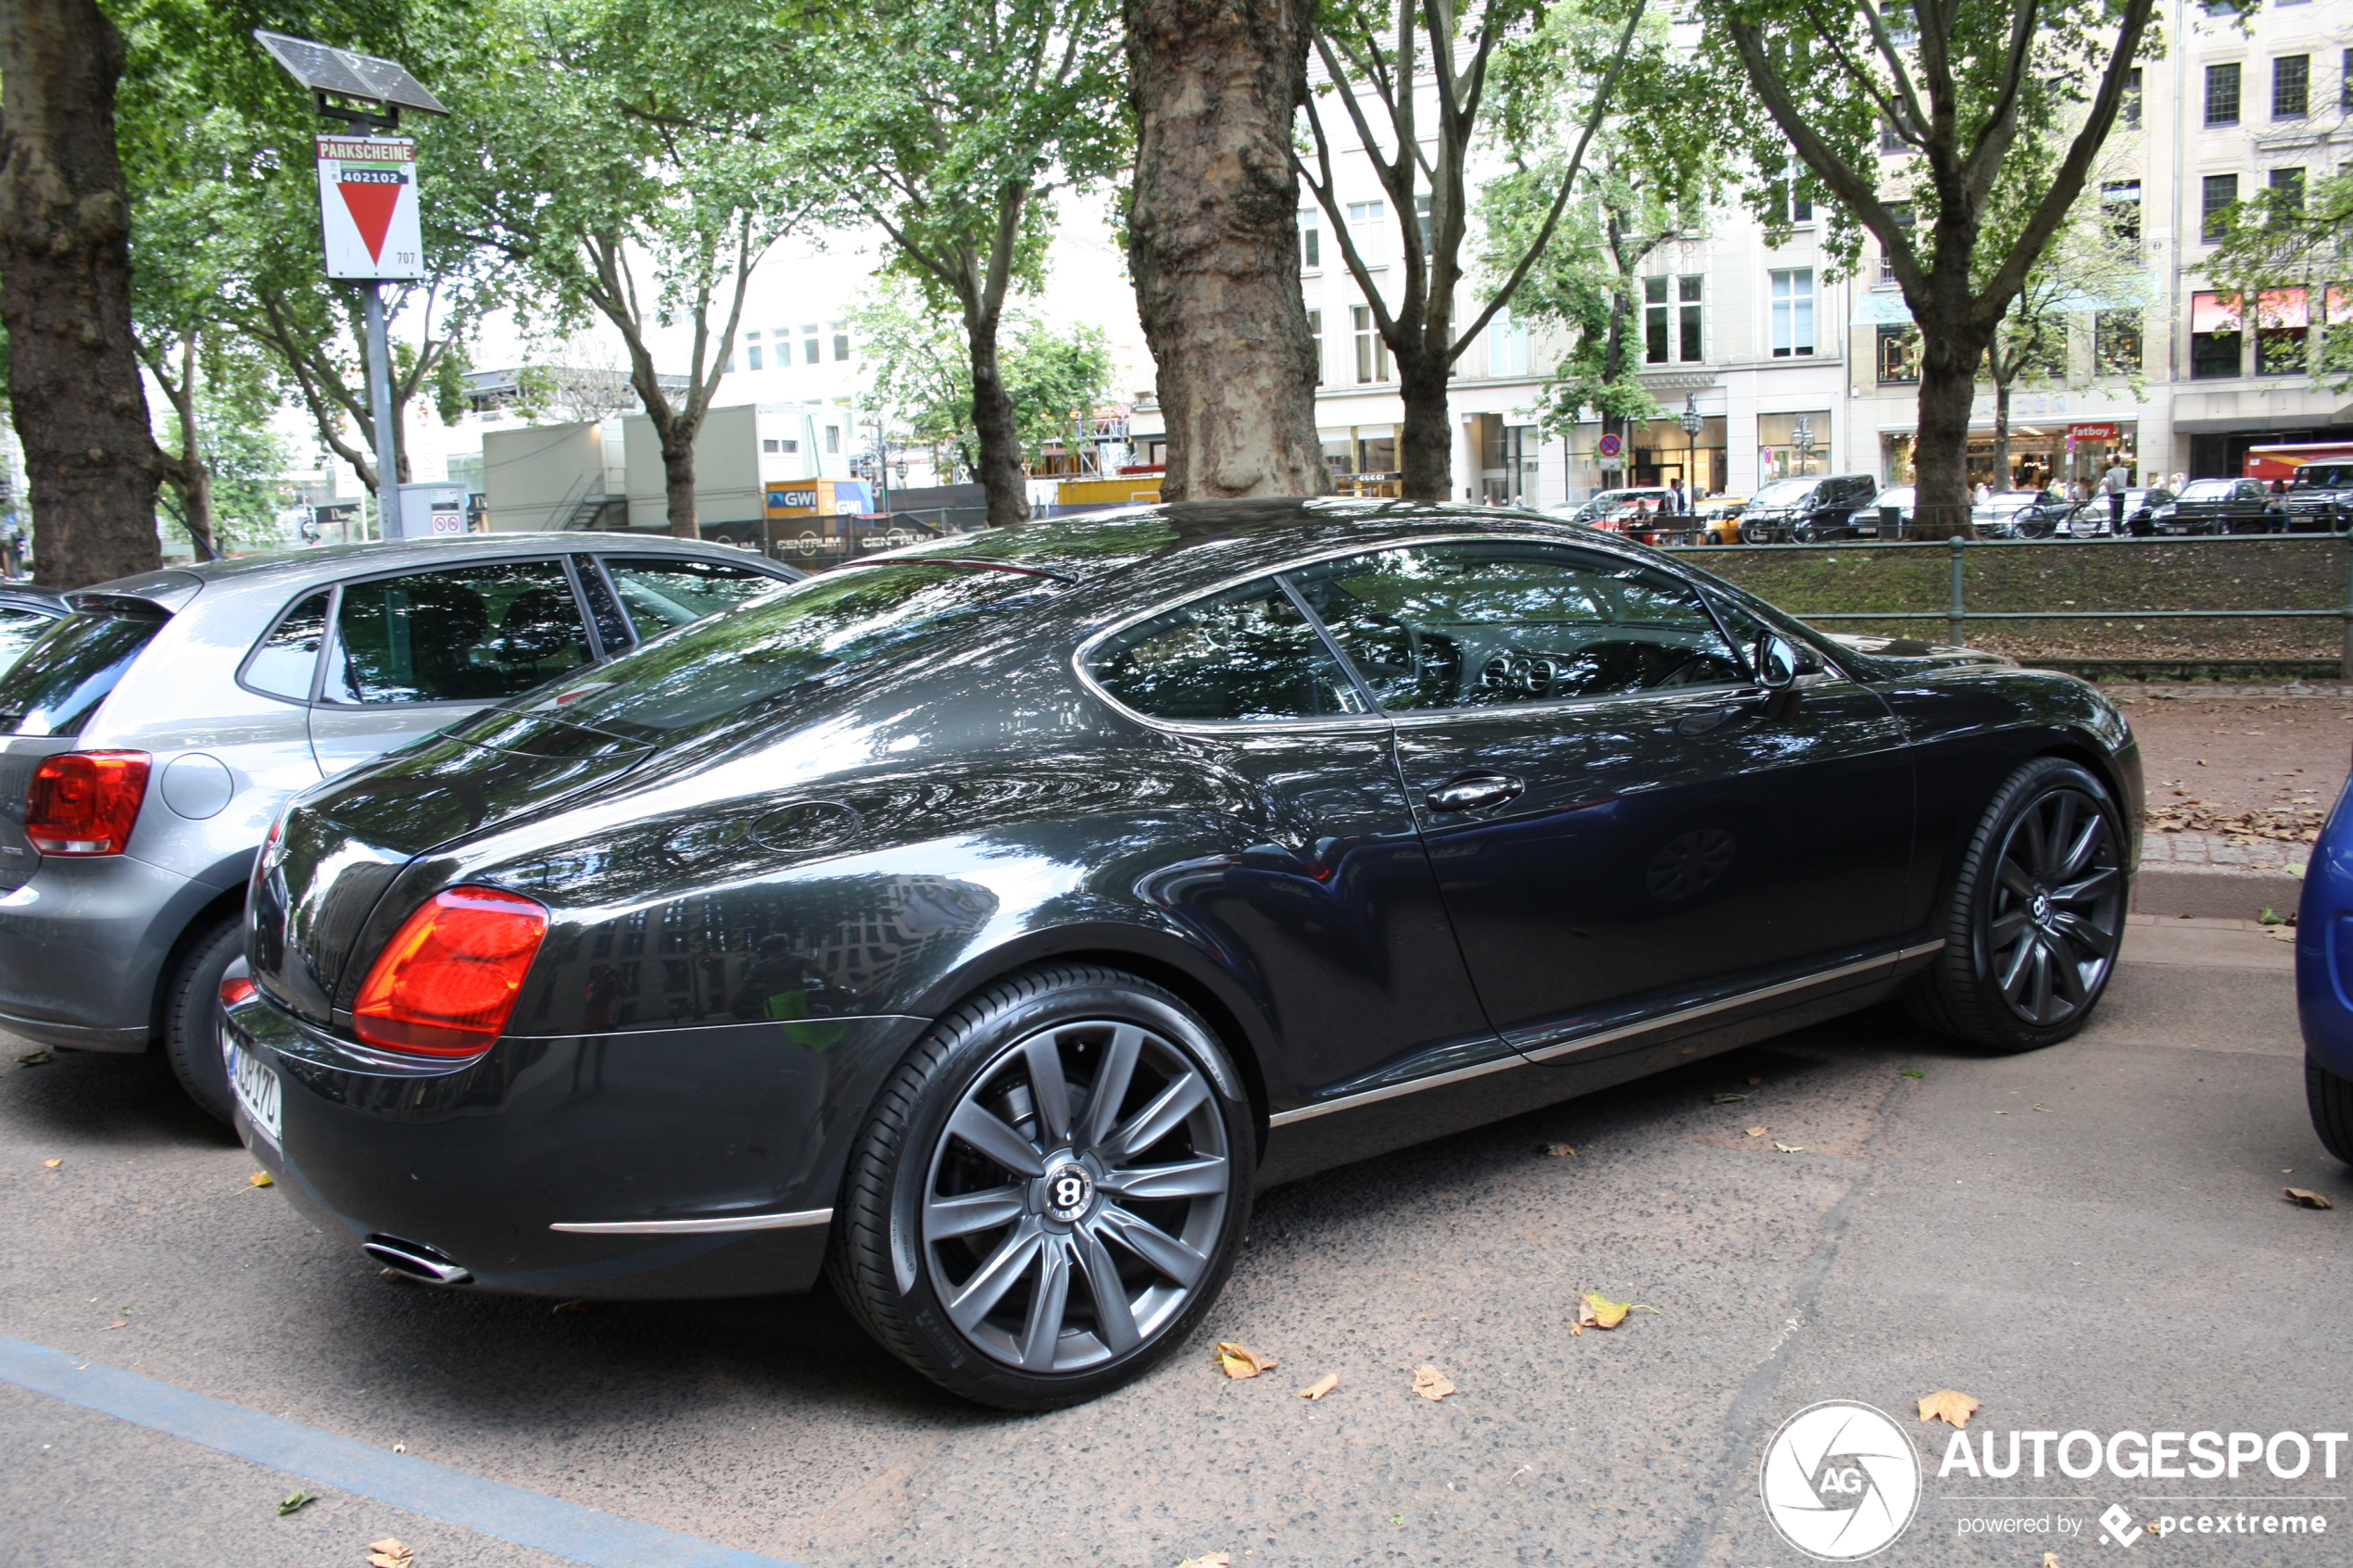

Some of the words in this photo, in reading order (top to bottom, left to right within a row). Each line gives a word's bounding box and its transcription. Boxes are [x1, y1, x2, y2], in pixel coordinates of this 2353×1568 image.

[321, 144, 411, 160] PARKSCHEINE
[344, 172, 398, 183] 402102
[396, 252, 416, 264] 707
[2071, 426, 2110, 438] fatboy
[785, 492, 816, 506] GWI
[836, 500, 862, 515] GWI
[776, 537, 841, 549] CENTRUM
